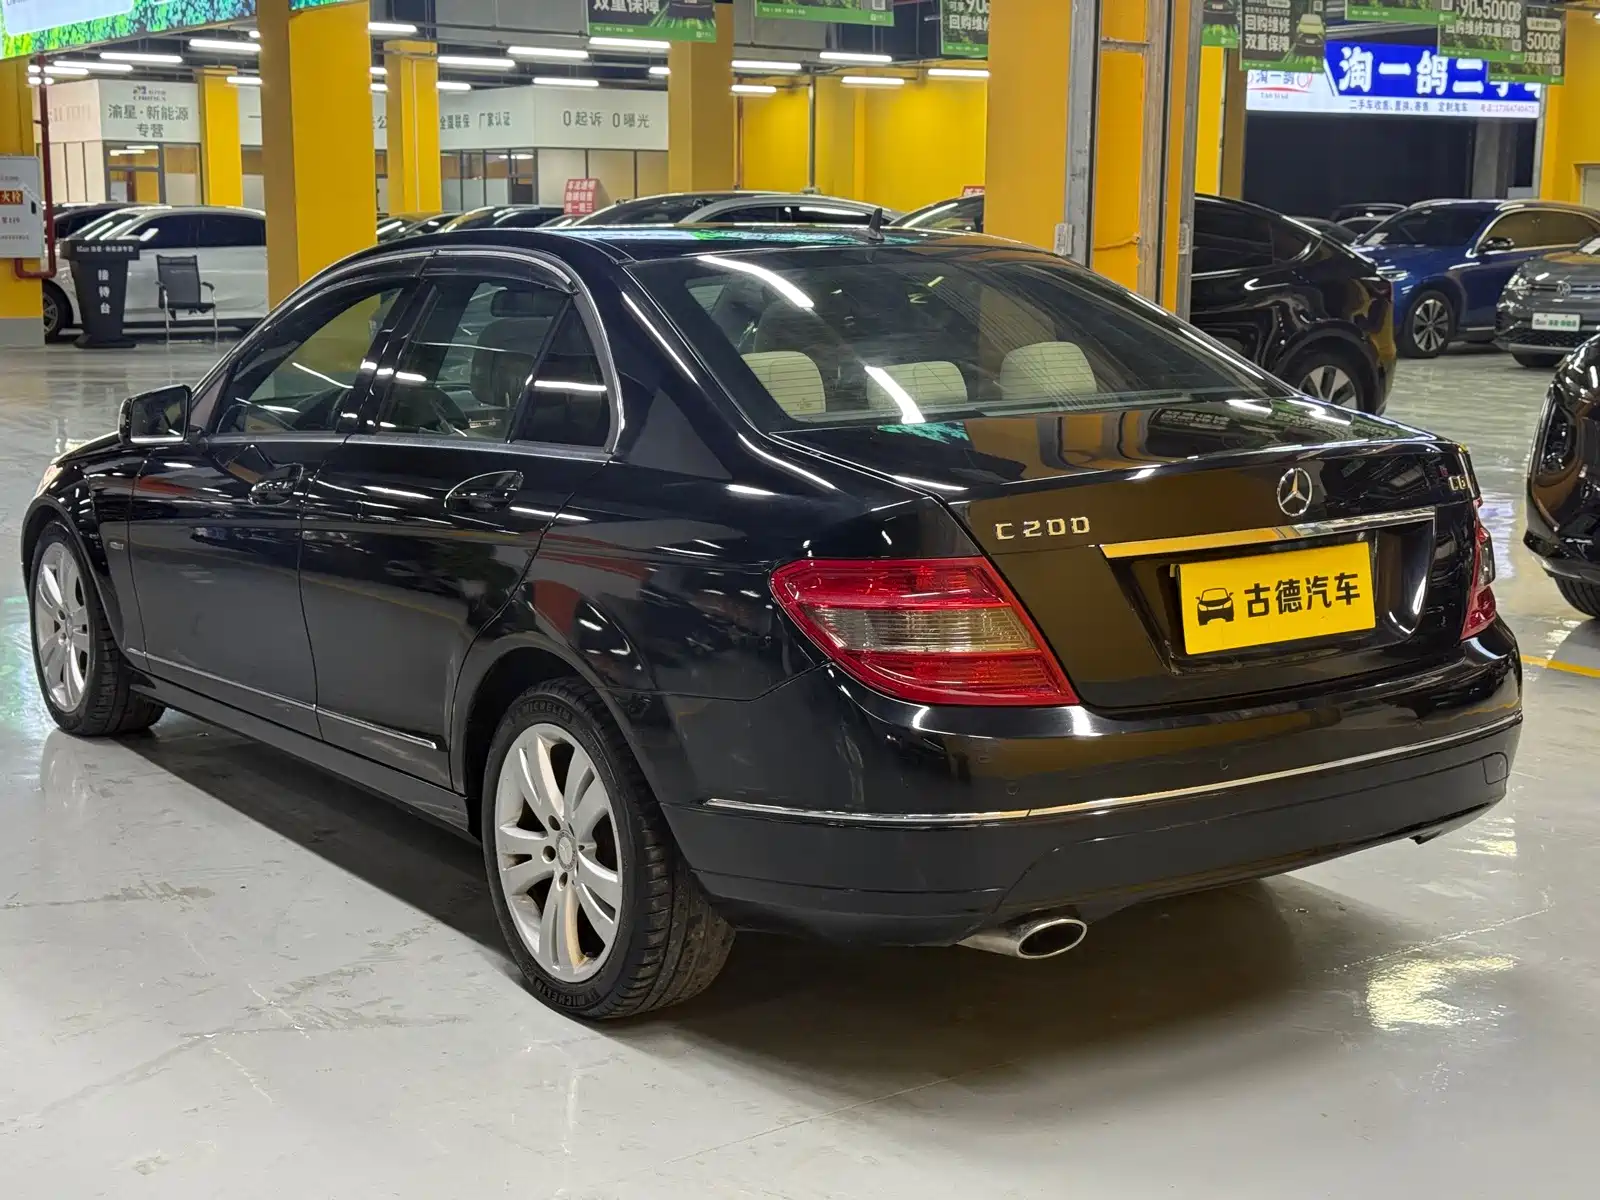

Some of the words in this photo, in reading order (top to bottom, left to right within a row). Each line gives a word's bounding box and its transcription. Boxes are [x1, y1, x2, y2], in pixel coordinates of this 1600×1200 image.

[995, 522, 1015, 540] C
[1022, 516, 1090, 538] 200
[1244, 572, 1360, 618] 古德汽车
